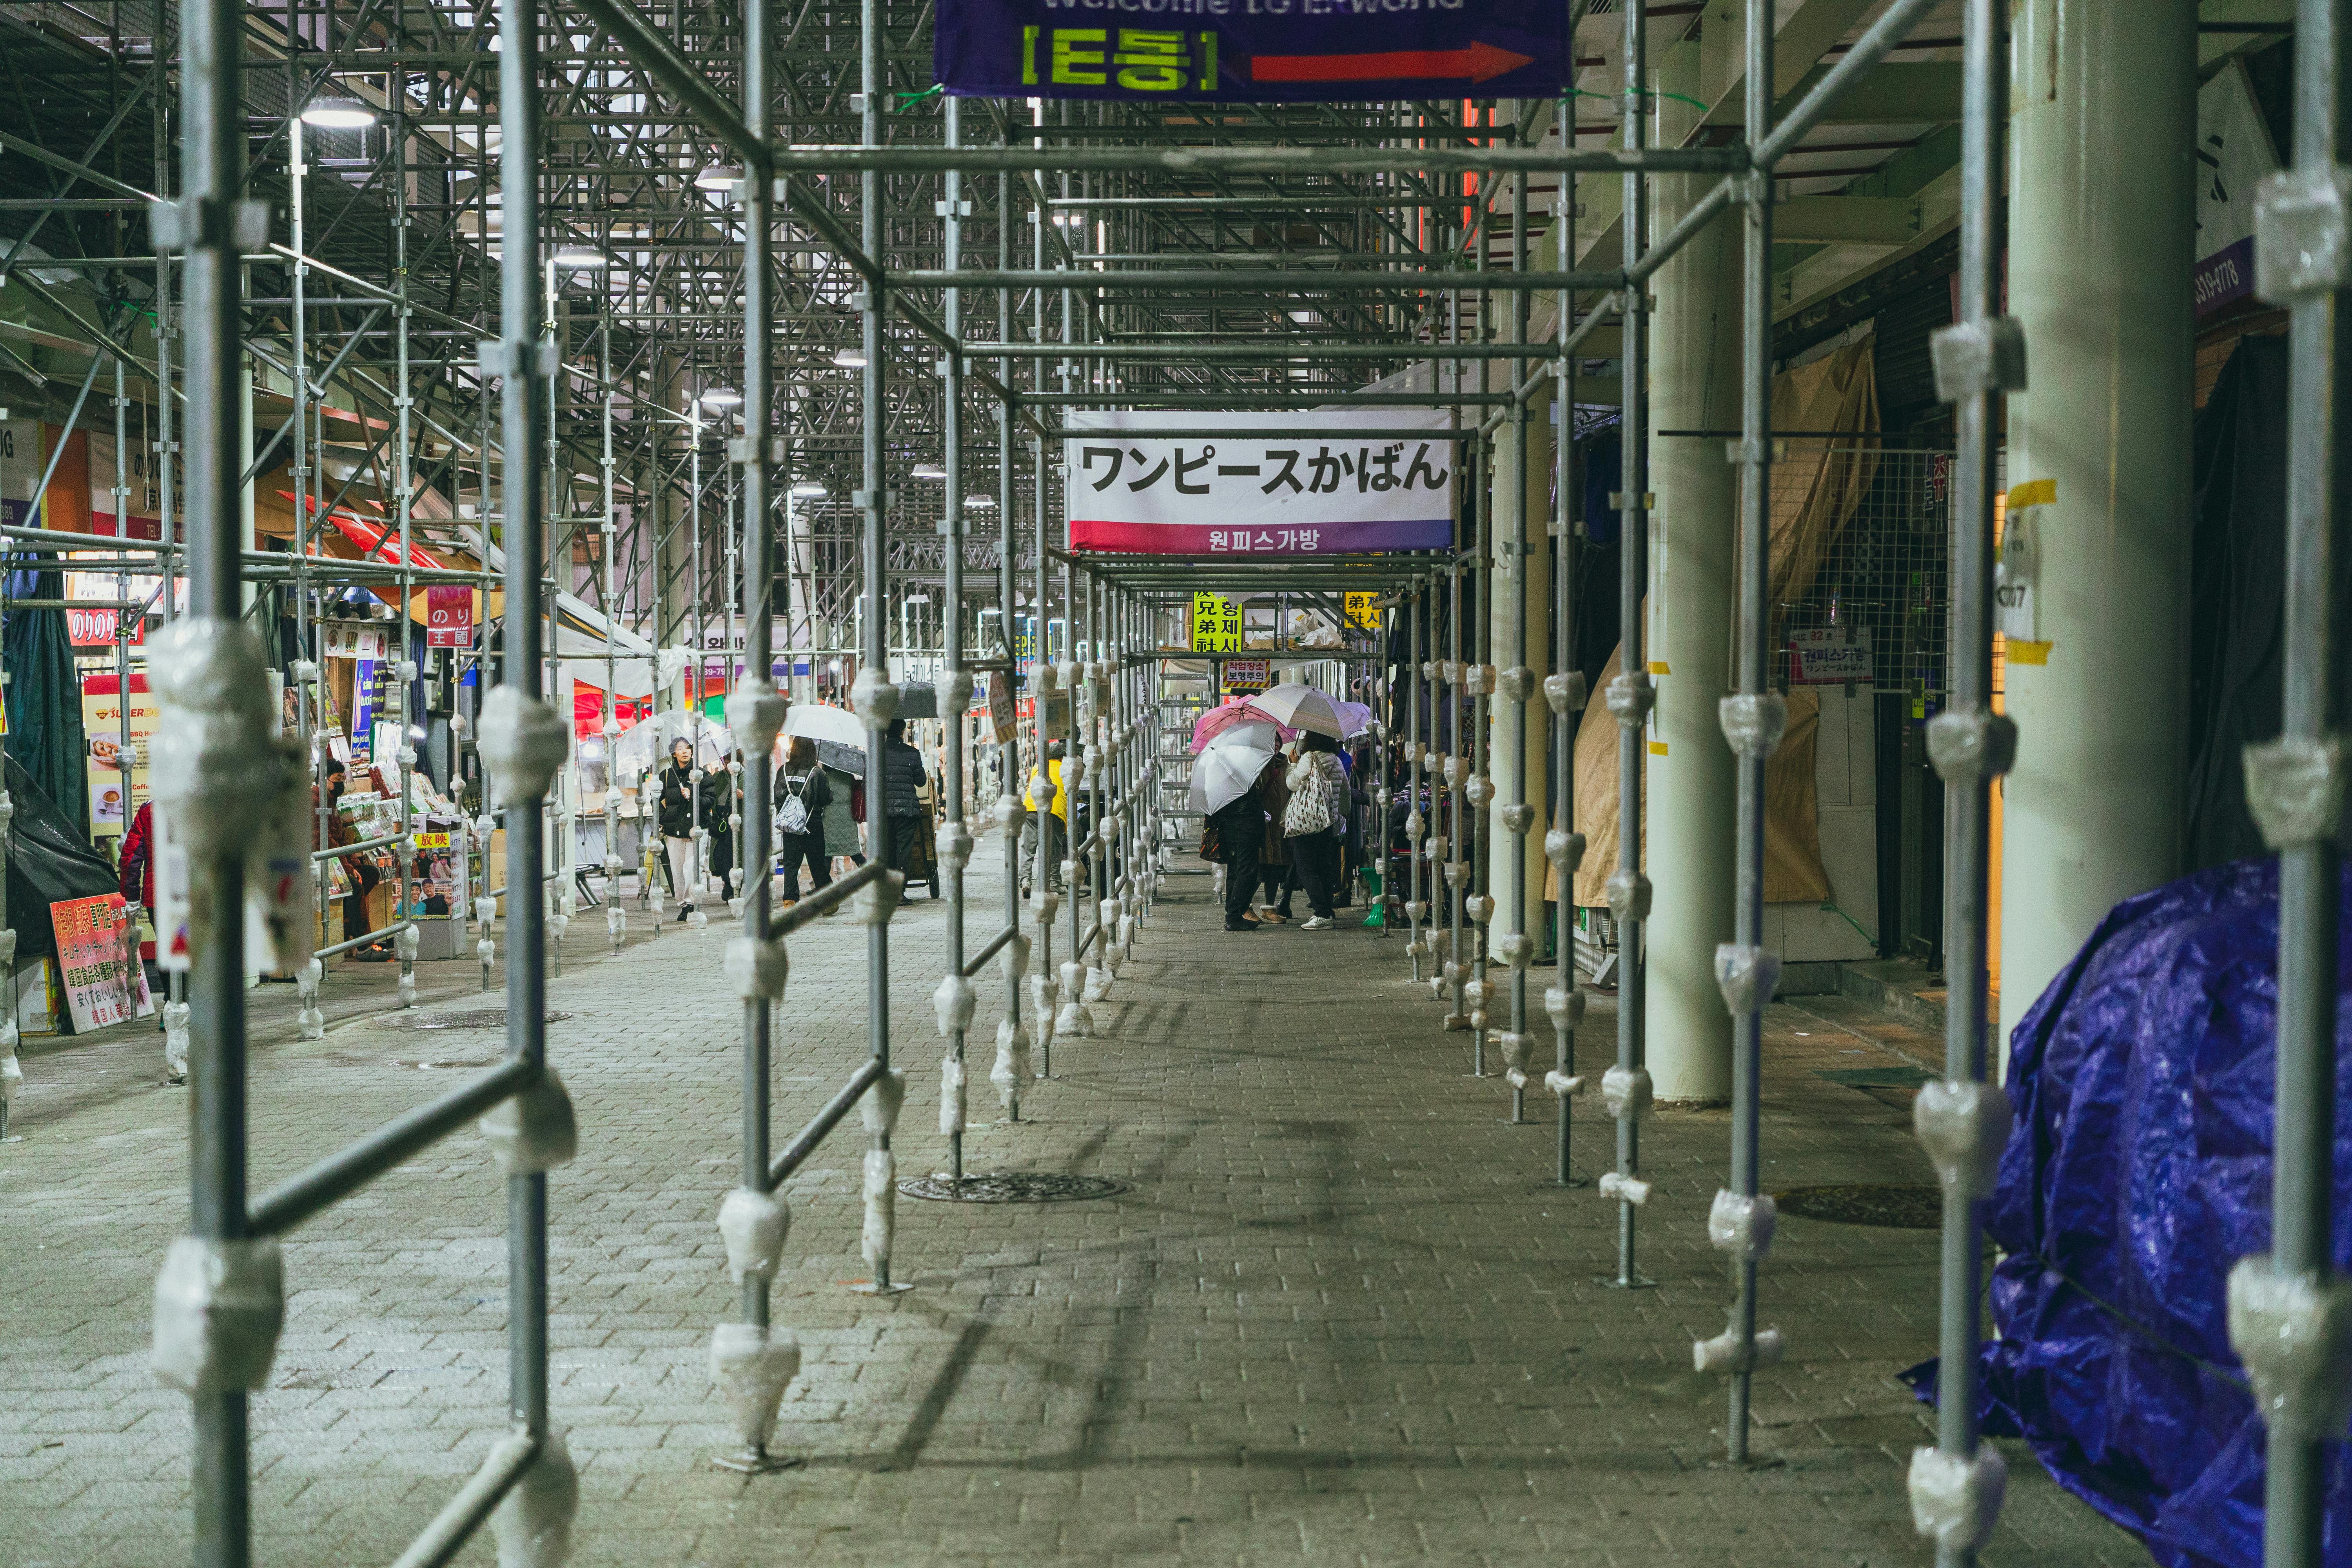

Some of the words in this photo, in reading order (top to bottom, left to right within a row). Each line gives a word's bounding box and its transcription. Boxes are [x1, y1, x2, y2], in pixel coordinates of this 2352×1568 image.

[1083, 443, 1449, 495] ワンピースかばん
[1209, 529, 1320, 552] 원피스가방
[432, 609, 468, 625] のり
[1229, 662, 1264, 671] 작업장소
[1229, 672, 1264, 681] 보행주의
